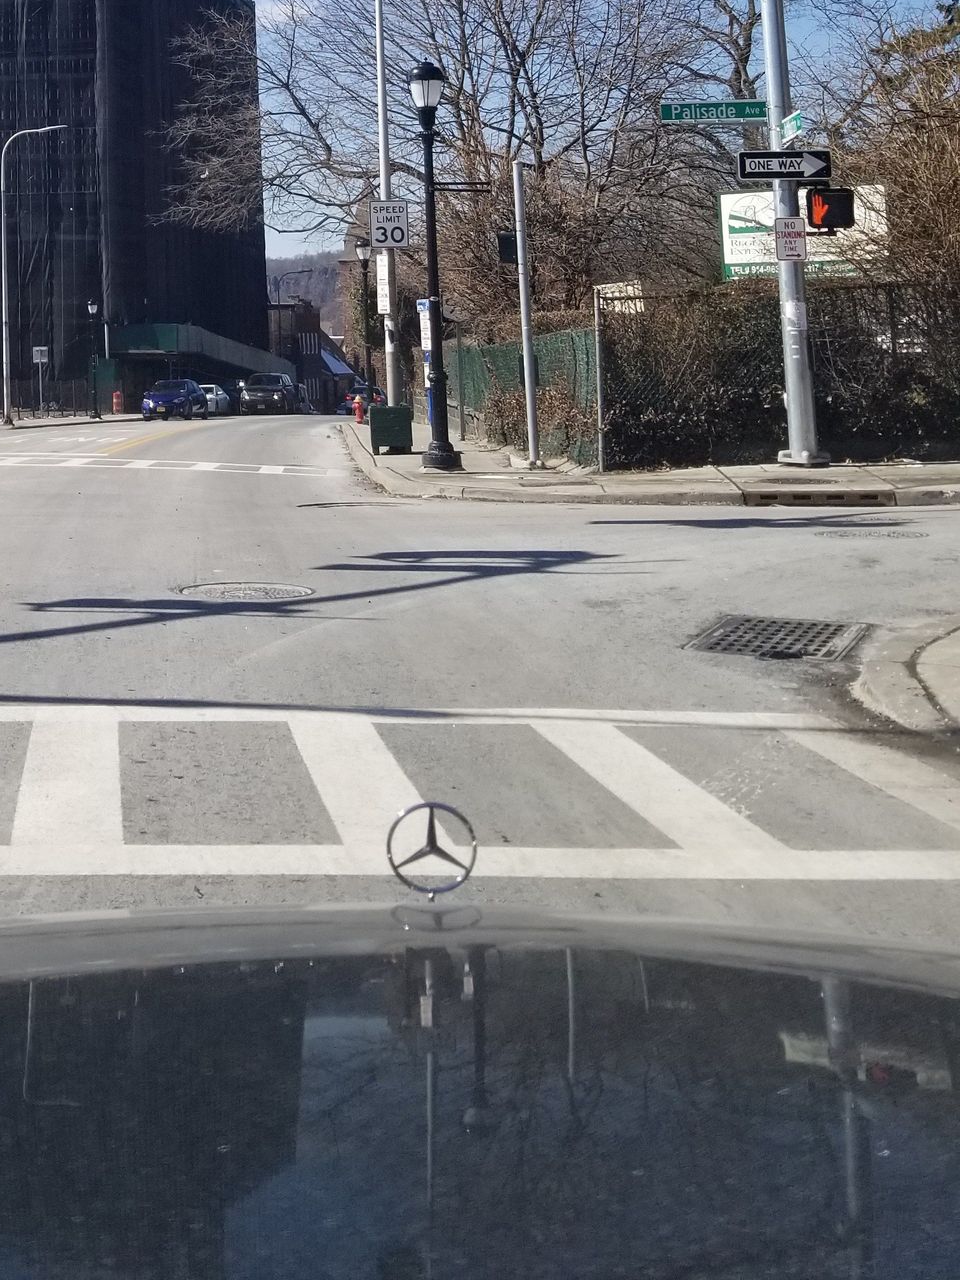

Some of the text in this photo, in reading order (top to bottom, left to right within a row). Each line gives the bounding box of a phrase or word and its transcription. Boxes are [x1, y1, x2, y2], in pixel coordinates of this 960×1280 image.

[671, 104, 760, 119] Palisade Ave
[749, 159, 803, 170] ONE WAY
[375, 226, 405, 243] 30
